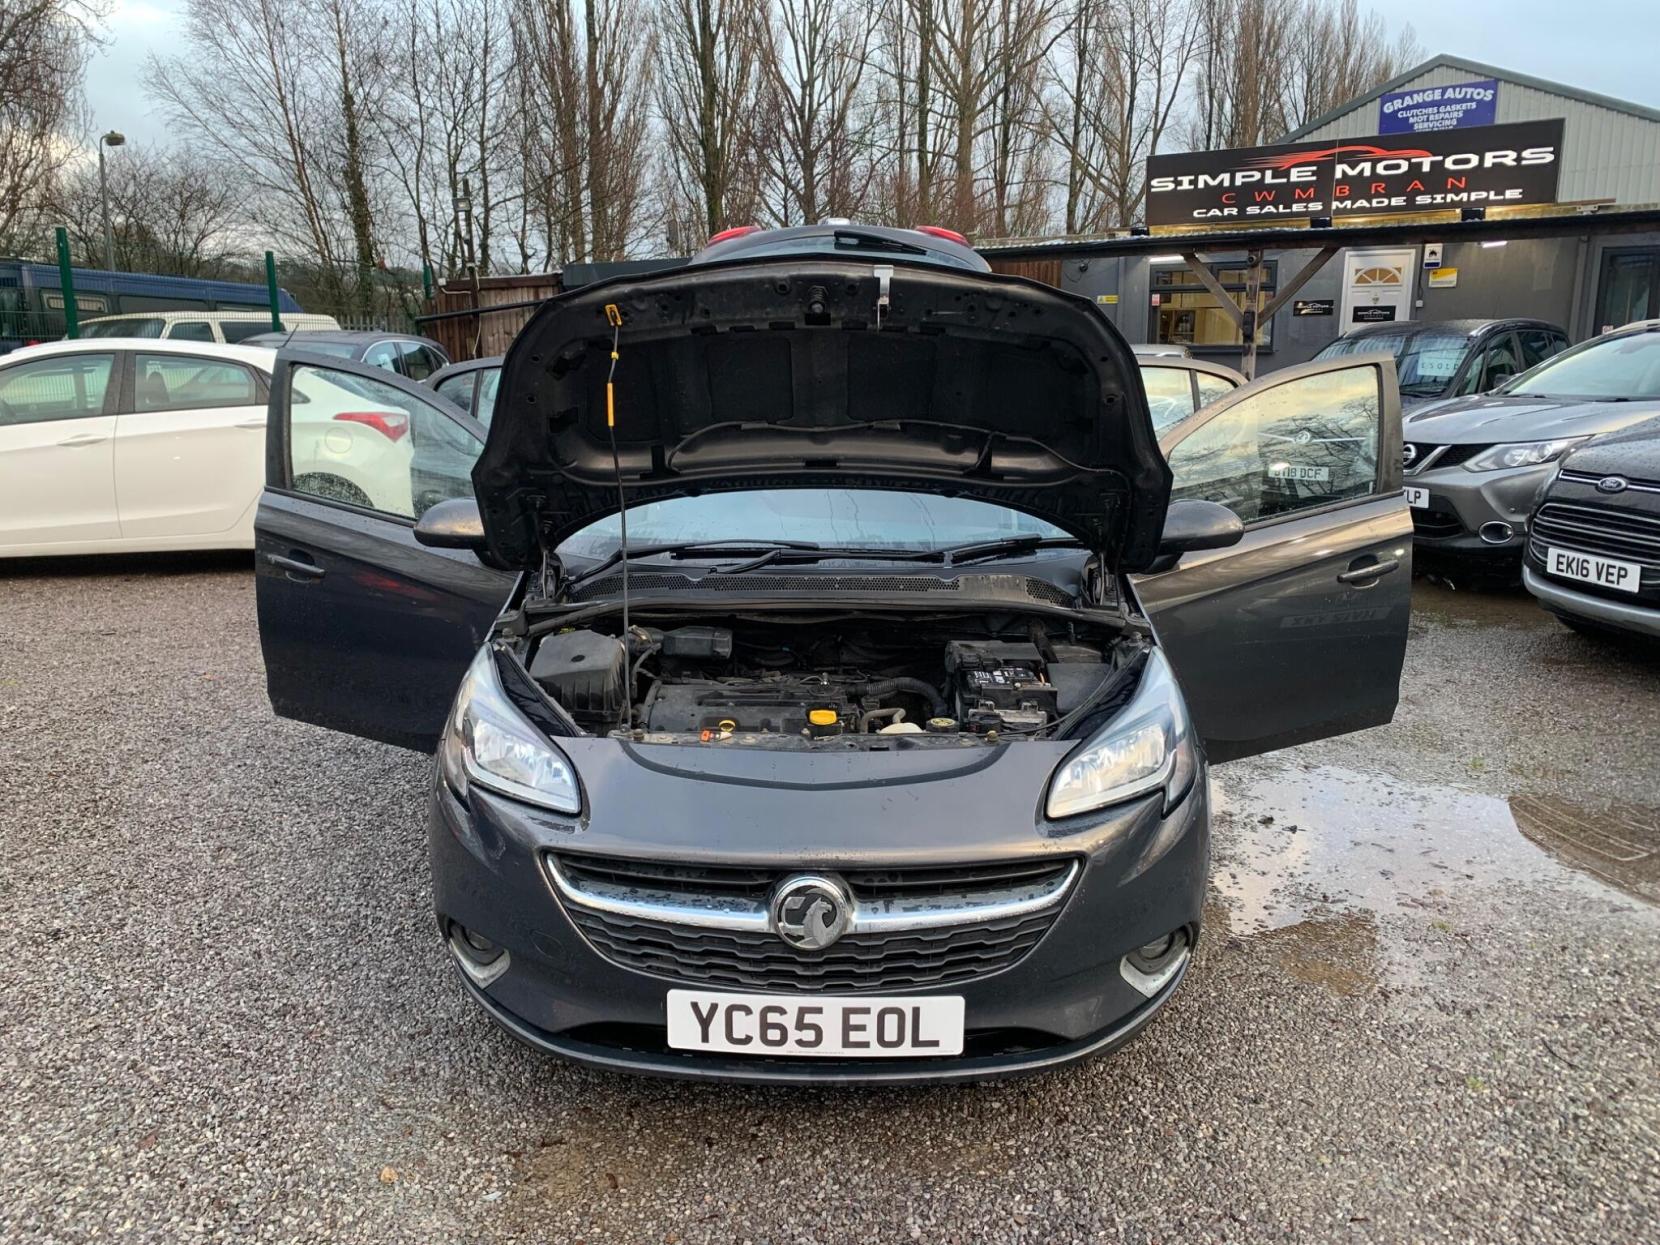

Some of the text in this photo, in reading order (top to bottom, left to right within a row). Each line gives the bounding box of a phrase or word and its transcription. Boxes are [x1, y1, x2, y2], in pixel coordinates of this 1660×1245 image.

[1383, 87, 1494, 113] GRANGE AUTOS
[1397, 101, 1477, 118] CLUTCHES GASKETS
[1409, 111, 1463, 124] MOT REPAIRS
[1413, 118, 1457, 130] SERVICING
[1150, 147, 1555, 192] SIMPLE MOTORS
[1193, 189, 1523, 218] CAR SALES MADE SIMPLE
[1221, 177, 1467, 204] CWMBRAN
[1300, 467, 1322, 479] DCF
[1403, 489, 1422, 505] LP
[1556, 553, 1628, 586] EK16 VEP
[690, 1001, 940, 1049] YC65 EOL
